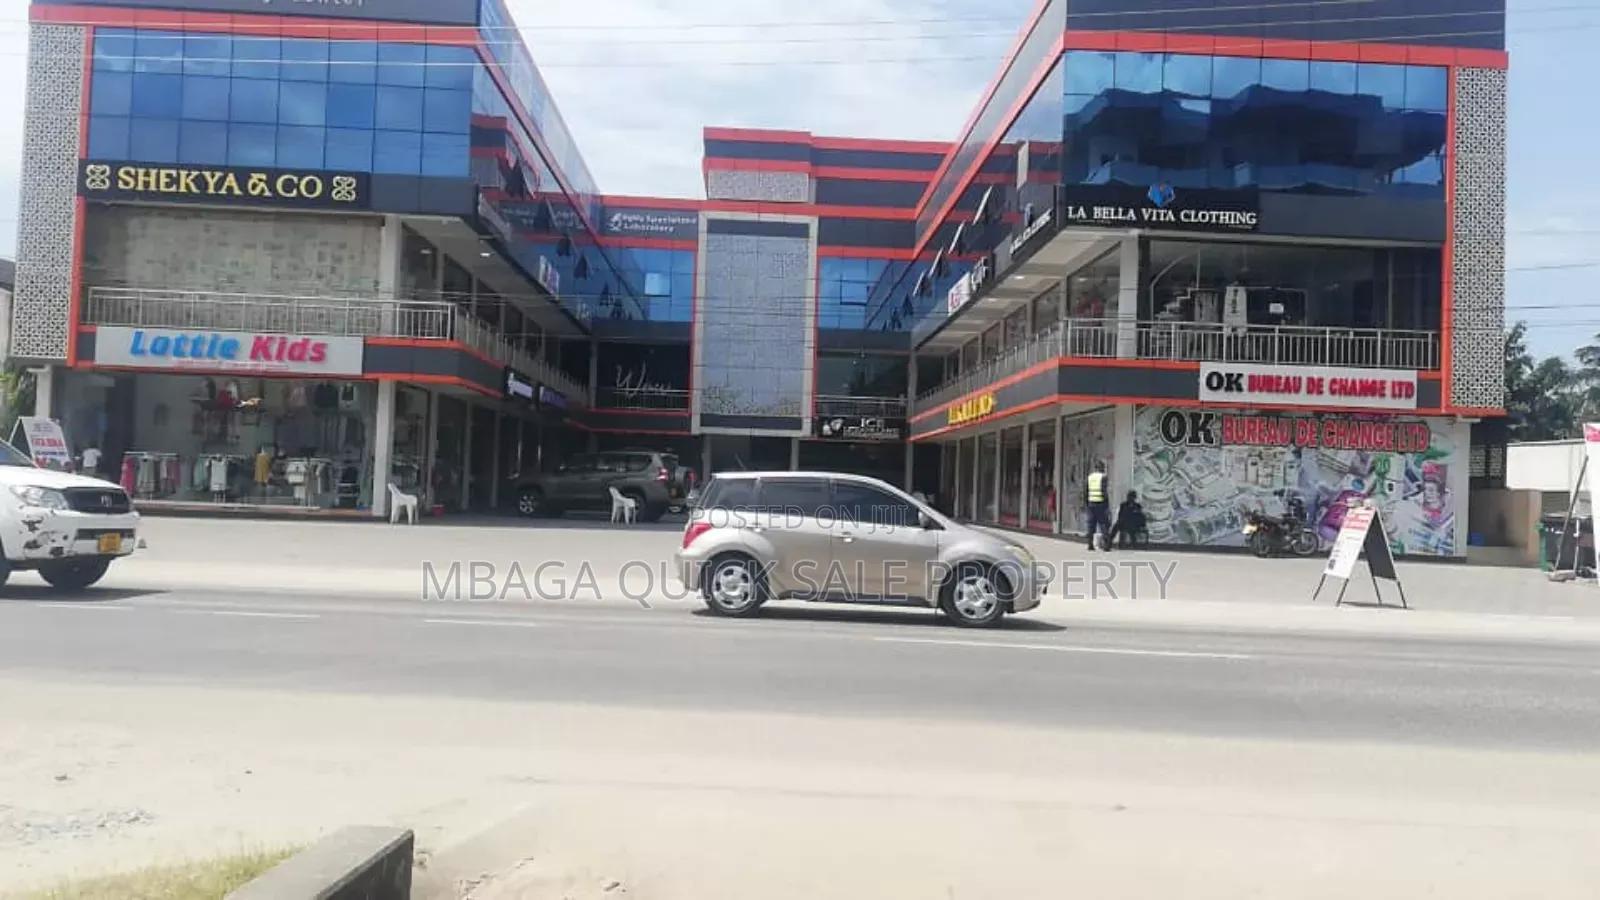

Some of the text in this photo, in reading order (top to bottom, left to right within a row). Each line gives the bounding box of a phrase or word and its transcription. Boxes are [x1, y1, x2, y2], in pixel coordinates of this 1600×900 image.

[117, 166, 323, 198] SHEKYA & CO
[1068, 206, 1257, 225] LA BELLA VITA CLOTHING
[249, 335, 329, 363] Kids
[1205, 371, 1415, 399] OK BUREAU DE CHANGE LTD
[1160, 410, 1431, 451] OK BUREAU DE CHANGE LTD
